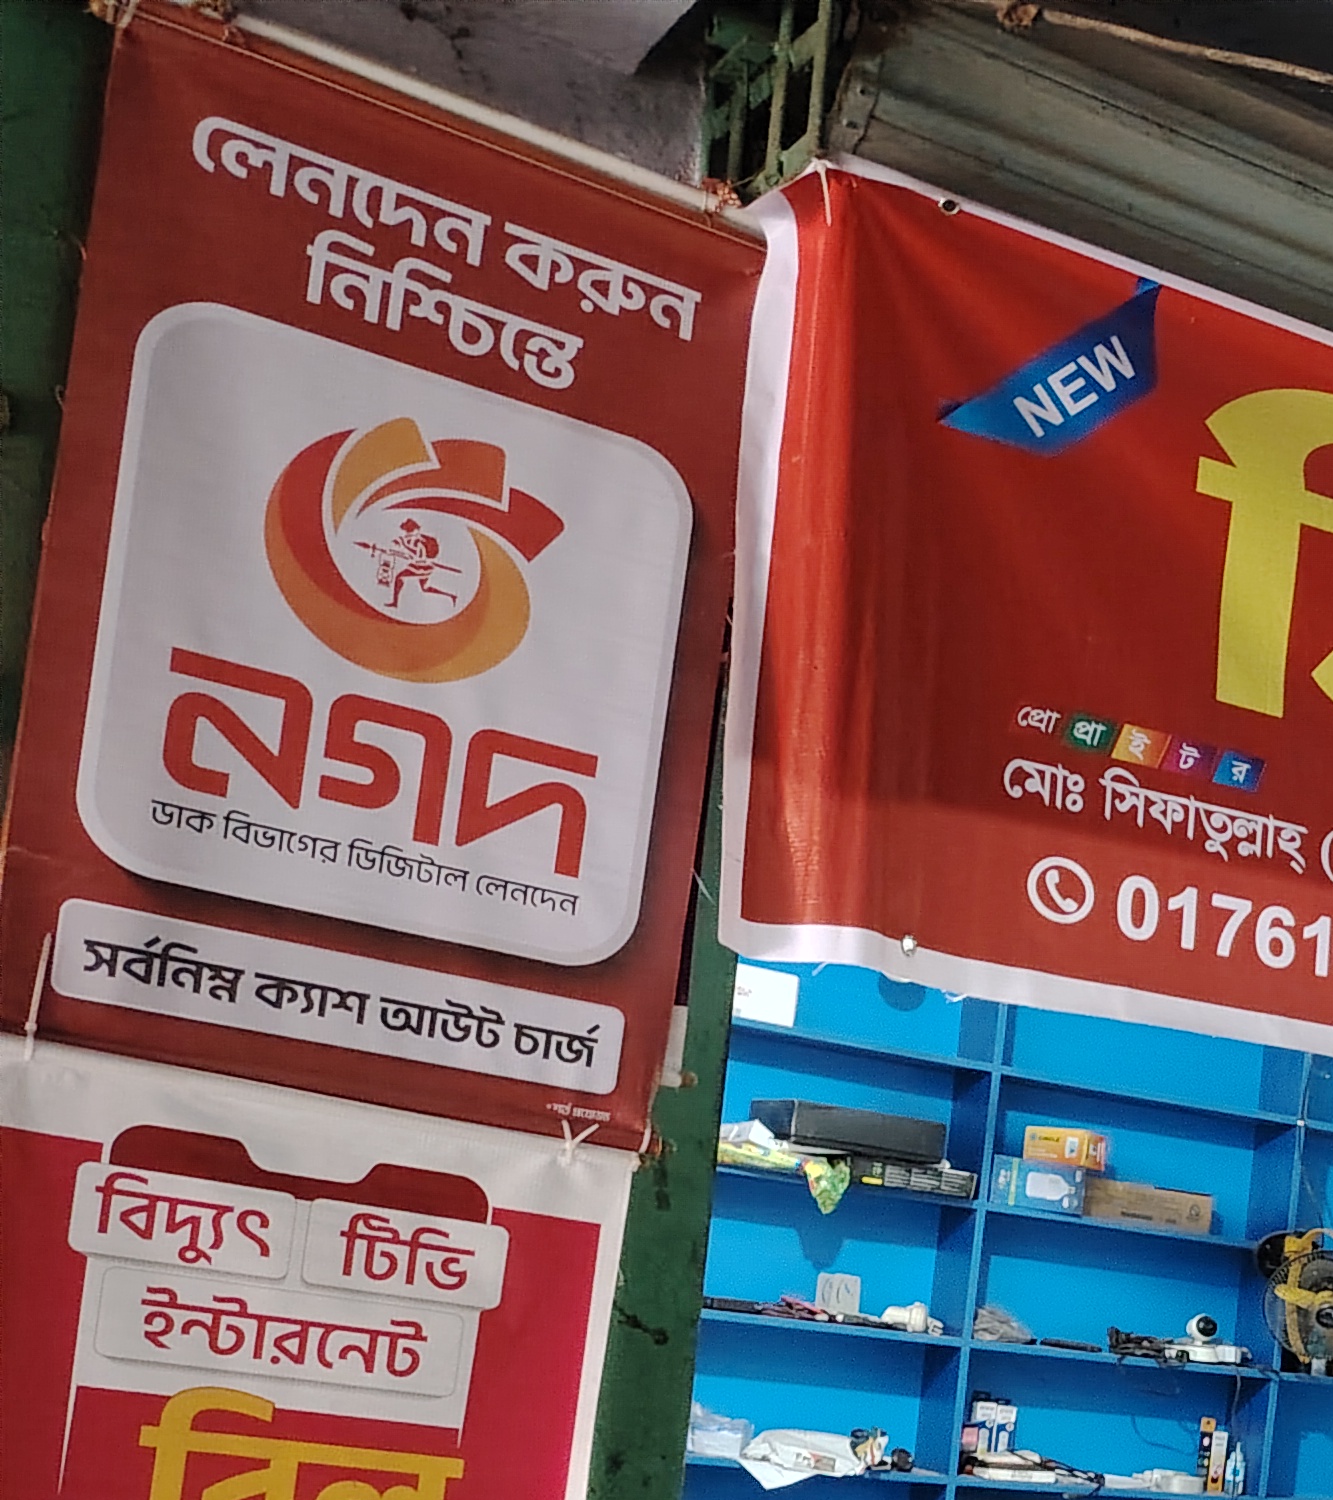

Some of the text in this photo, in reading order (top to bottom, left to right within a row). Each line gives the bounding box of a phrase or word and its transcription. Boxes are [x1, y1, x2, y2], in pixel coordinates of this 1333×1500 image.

[192, 115, 702, 342] লেনদেন করুন
[306, 228, 583, 390] নিশ্চিন্তে
[1012, 335, 1136, 438] NEW
[162, 647, 599, 878] নগদ
[1003, 757, 1085, 813] মোঃ
[151, 798, 579, 917] ডাক বিভাগের ডিজিটাল লেনদেন
[84, 935, 600, 1068] সর্বনিম্ন ক্যাশ আউট চার্জ
[95, 1172, 475, 1291] বিদ্যুৎ টিভি
[141, 1287, 428, 1378] ইন্টারনেট
